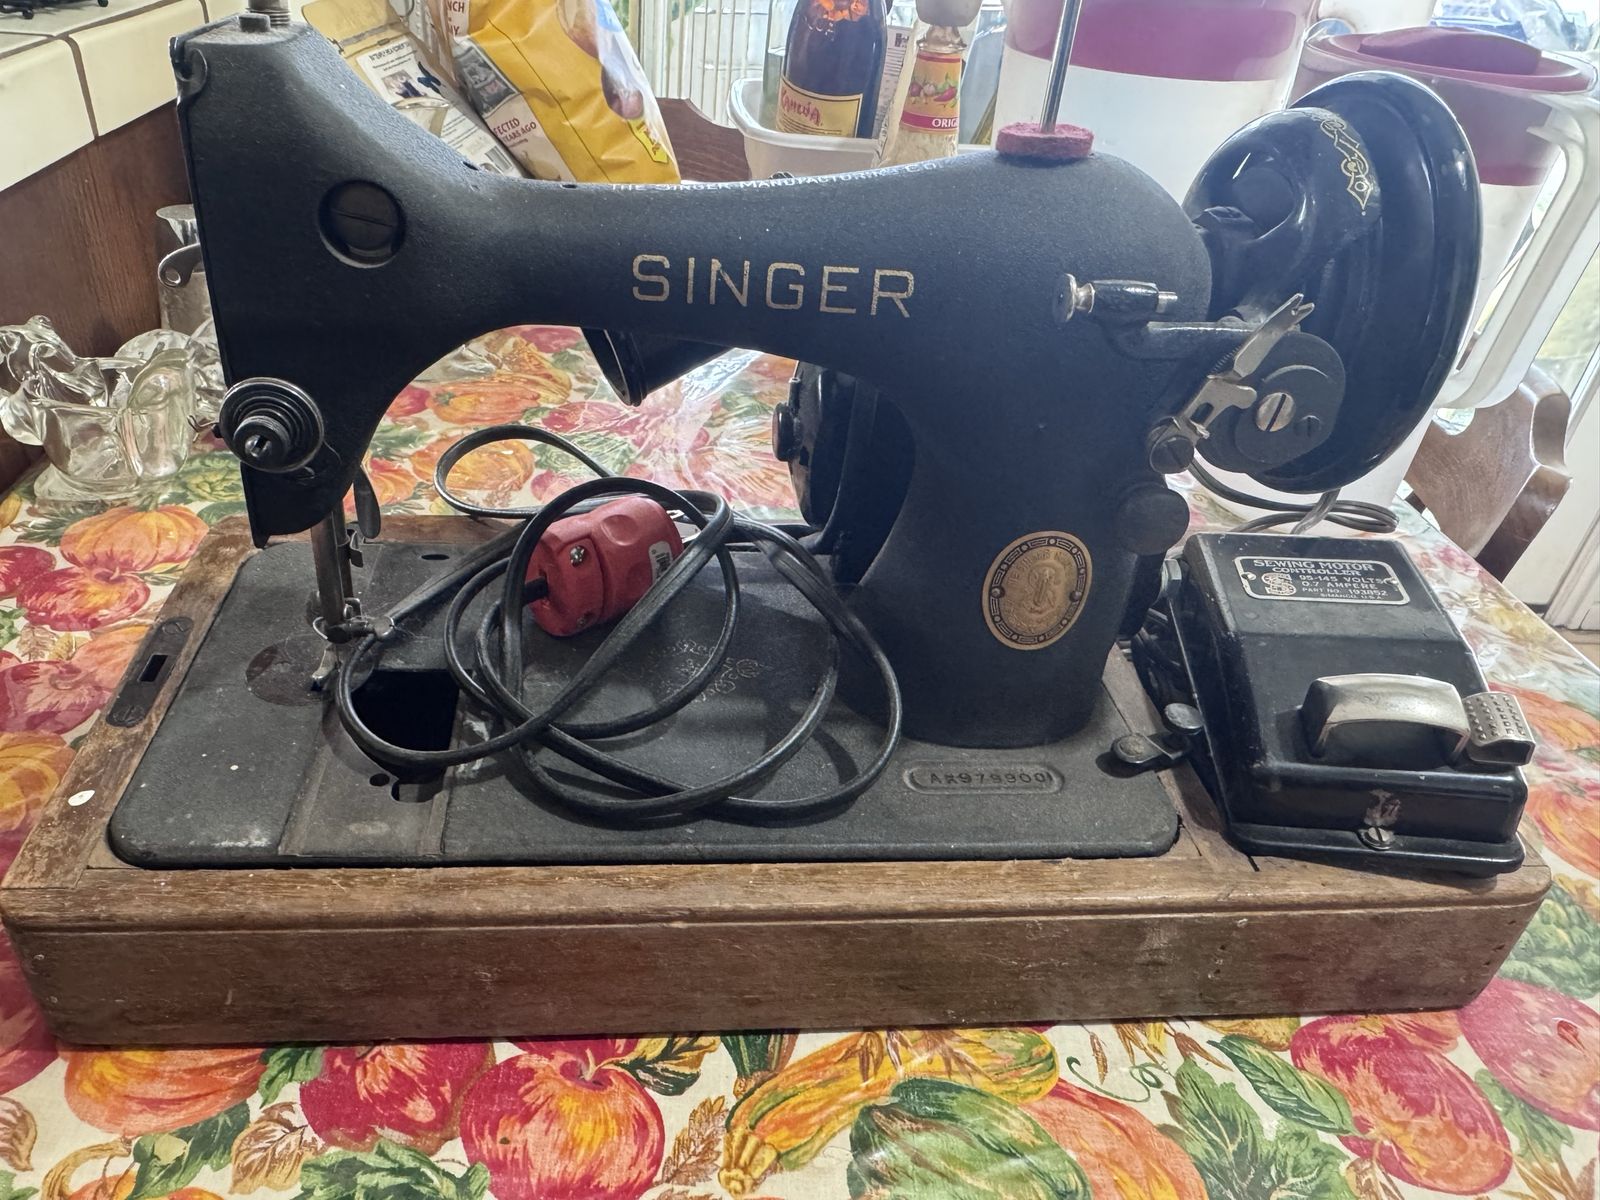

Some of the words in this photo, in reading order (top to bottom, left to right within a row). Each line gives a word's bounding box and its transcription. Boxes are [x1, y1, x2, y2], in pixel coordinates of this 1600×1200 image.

[521, 121, 537, 135] AGO
[632, 254, 915, 318] SINGER
[1253, 559, 1315, 570] SEWING
[1319, 561, 1375, 572] MOTOR
[1272, 567, 1362, 576] CONTROLLER
[1343, 576, 1384, 584] VOLTS
[1327, 582, 1378, 590] AMPERE
